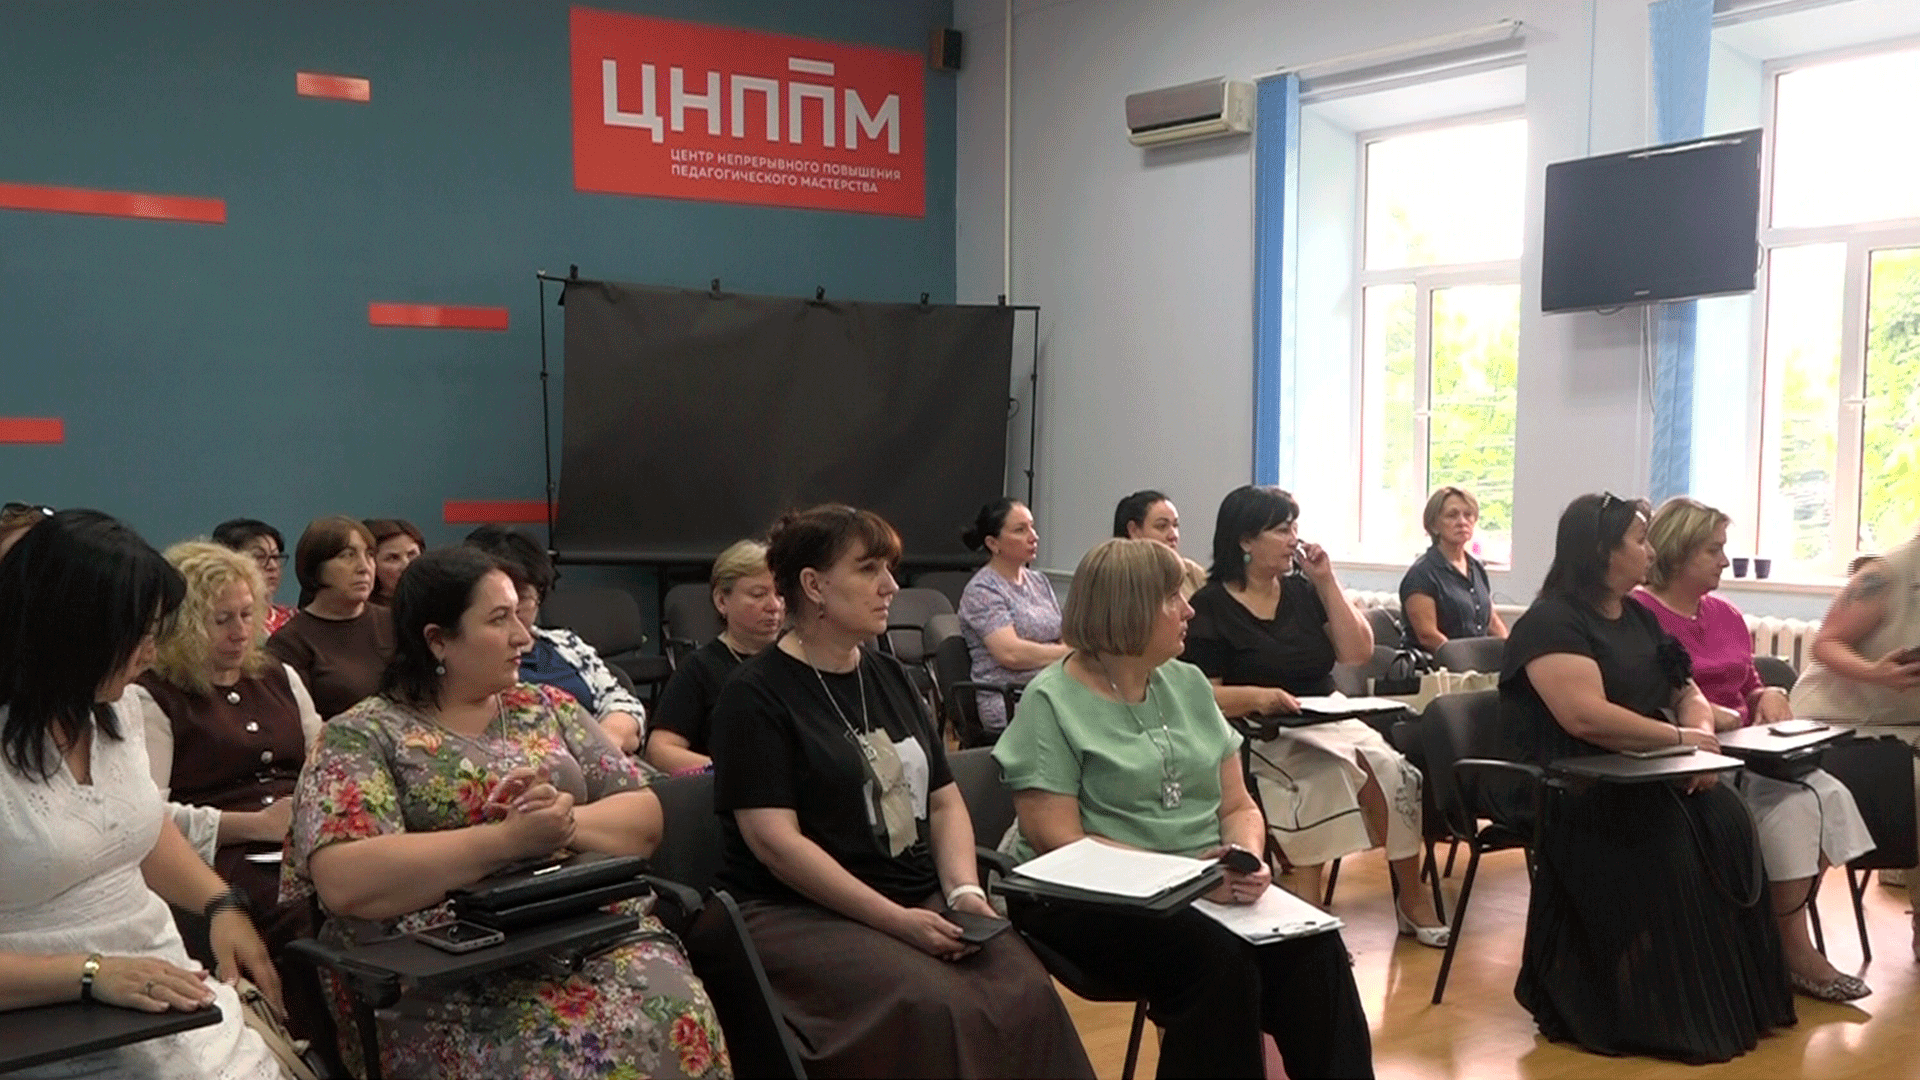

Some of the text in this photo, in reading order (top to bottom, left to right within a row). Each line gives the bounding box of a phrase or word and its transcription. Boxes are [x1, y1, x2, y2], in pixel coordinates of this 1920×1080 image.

[602, 57, 900, 154] ЦНППМ
[671, 149, 901, 180] ЦЕНТР НЕПРЕРЫВНОГО ПОВЫШЕНИЯ
[671, 164, 878, 193] ПЕДАГОГИЧЕСКОГО МАСТЕРСТВА
